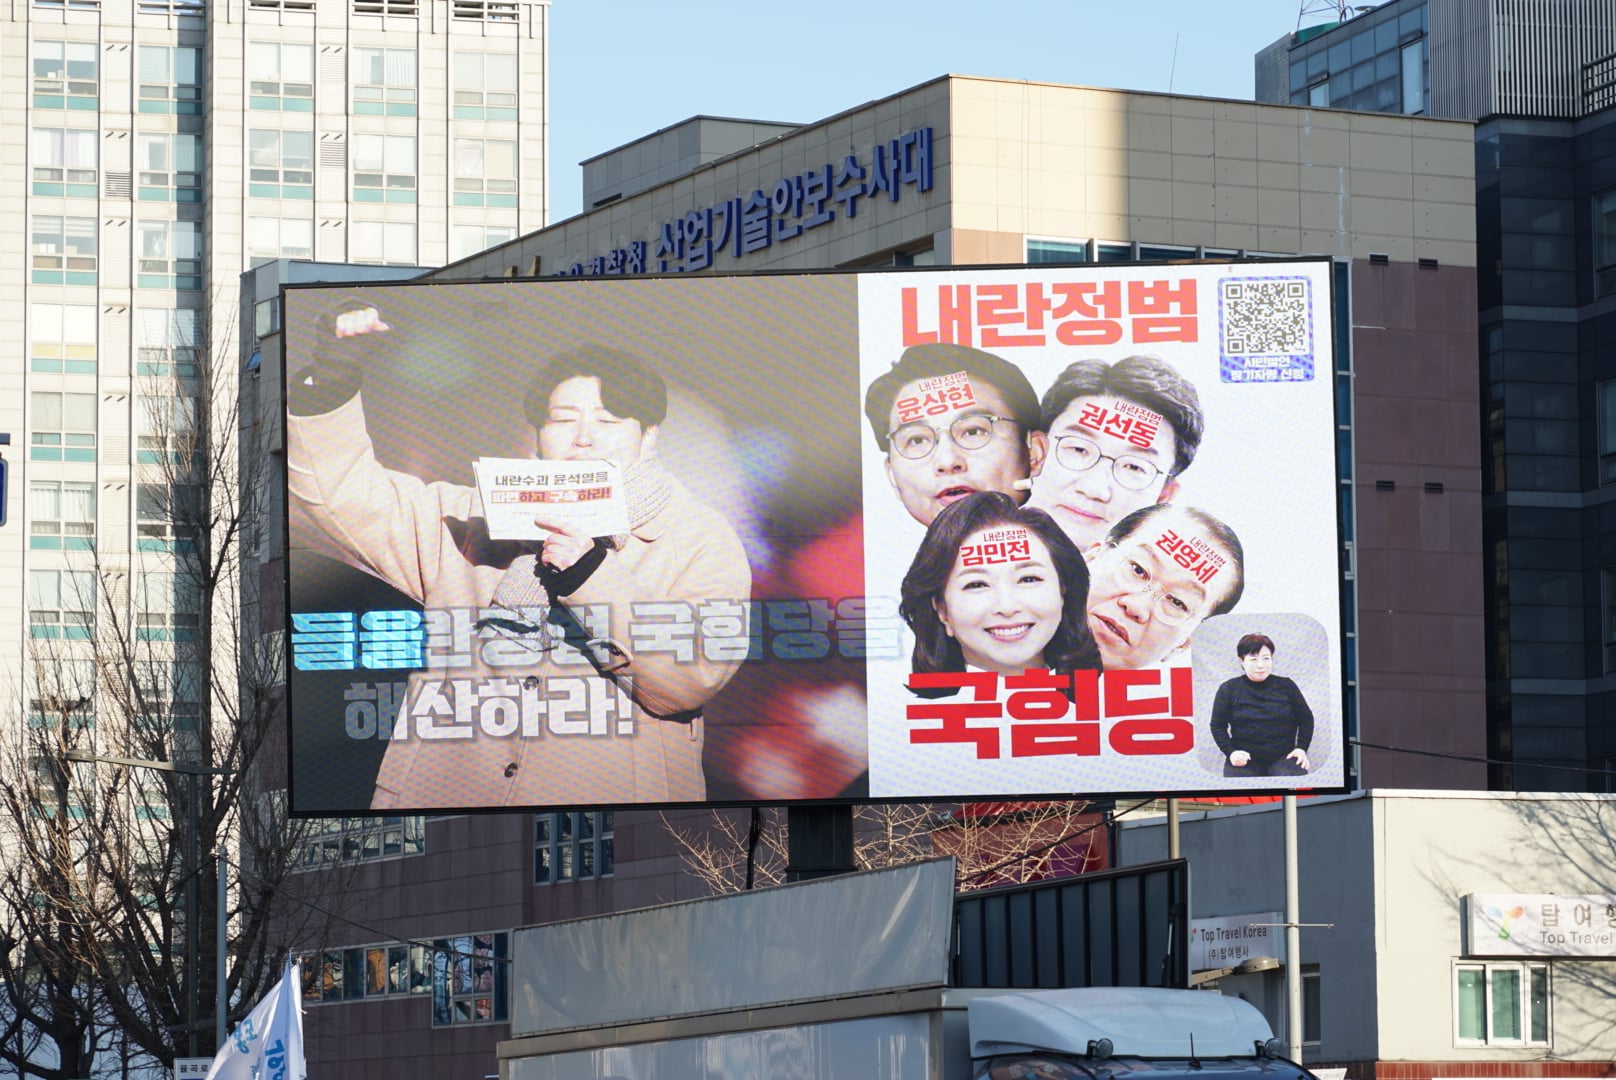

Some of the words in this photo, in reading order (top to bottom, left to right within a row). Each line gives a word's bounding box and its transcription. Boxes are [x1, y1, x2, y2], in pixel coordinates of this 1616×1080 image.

[655, 127, 934, 274] 산업기술안보수사대
[901, 278, 1198, 348] 내란정범
[919, 372, 967, 392] 내란정범
[896, 384, 976, 422] 윤상현
[1114, 400, 1162, 426] 내란정범
[1078, 402, 1158, 448] 권선동
[495, 475, 549, 486] 내란수괴
[553, 471, 609, 485] 윤석열을
[983, 529, 1027, 542] 내란정범
[960, 540, 1031, 566] 김민전
[1155, 529, 1219, 584] 권영세
[630, 598, 904, 664] 국힘당을
[343, 676, 634, 740] 해산하라!
[1201, 929, 1215, 943] Top
[1216, 926, 1241, 941] Travel
[1243, 926, 1267, 937] Korea
[1540, 931, 1565, 945] Top
[1570, 931, 1613, 945] Travel
